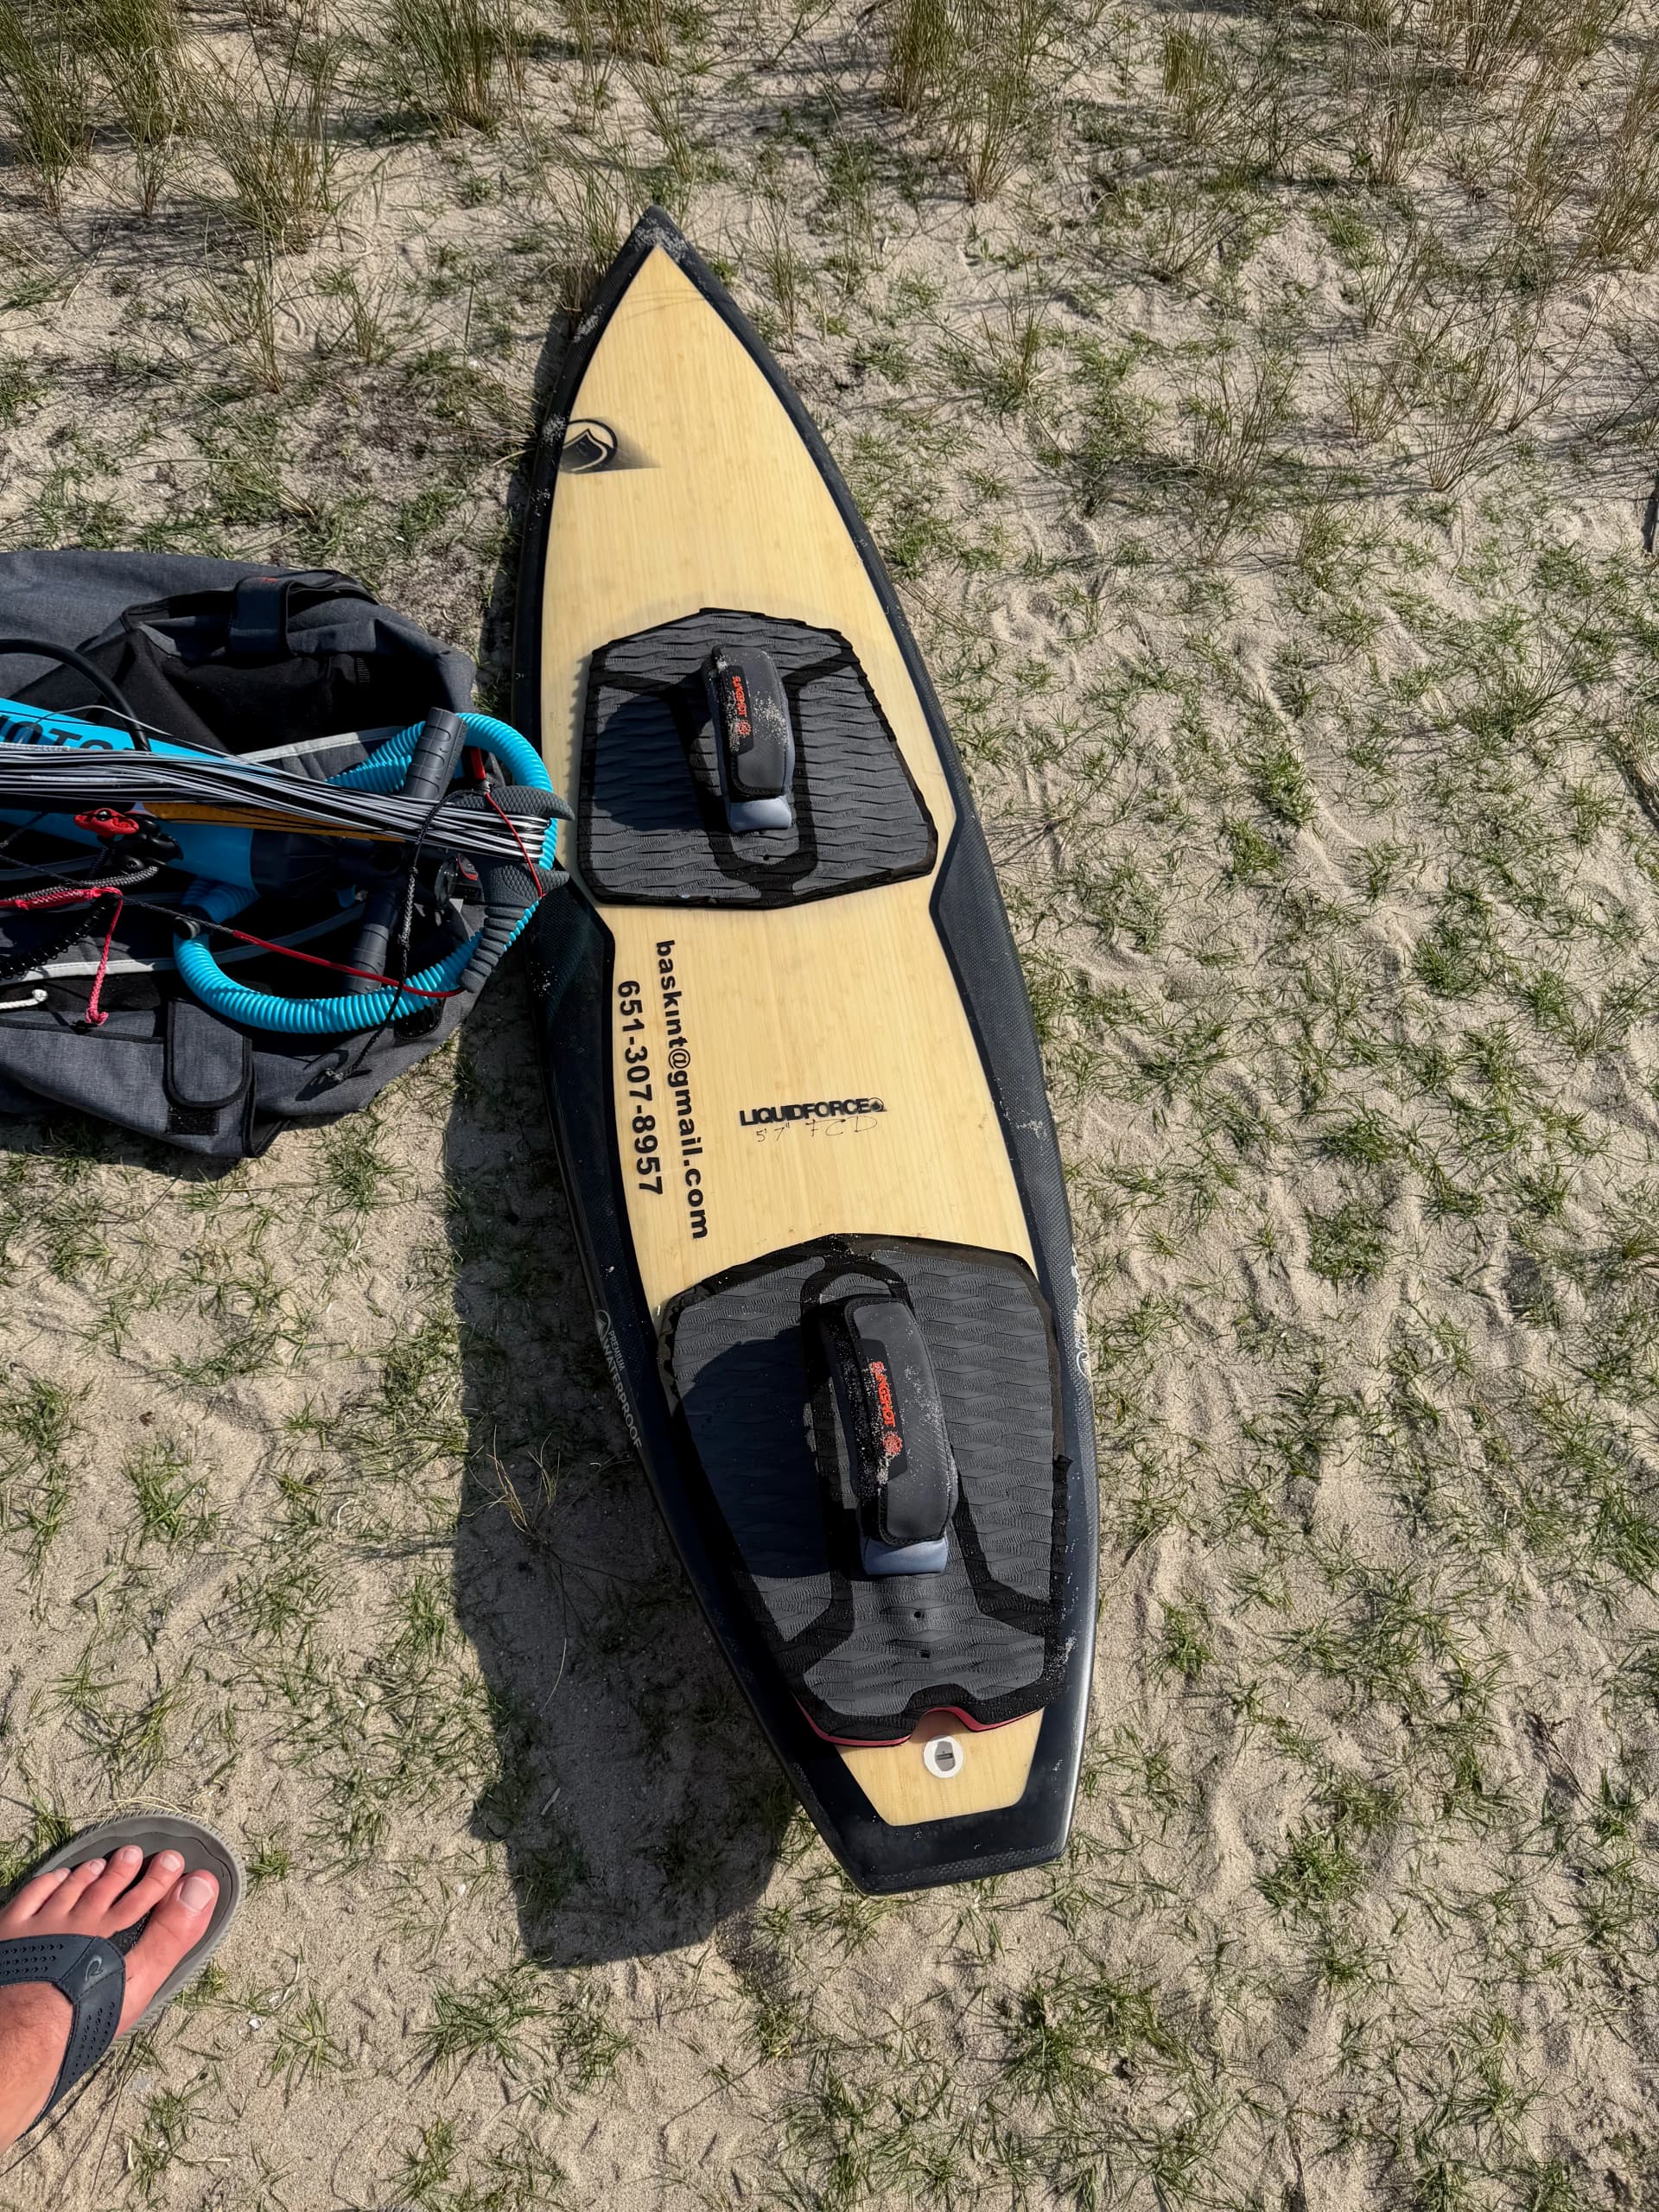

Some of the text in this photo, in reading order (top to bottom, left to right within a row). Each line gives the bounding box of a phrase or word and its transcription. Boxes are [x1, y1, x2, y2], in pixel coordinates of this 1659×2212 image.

[617, 980, 664, 1195] 651-307-8957
[656, 939, 708, 1239] baskint@gmail.com
[739, 1097, 872, 1127] LIQUIDFORCE
[602, 1338, 643, 1448] WATERPROOF
[608, 1331, 626, 1372] PREMIUM
